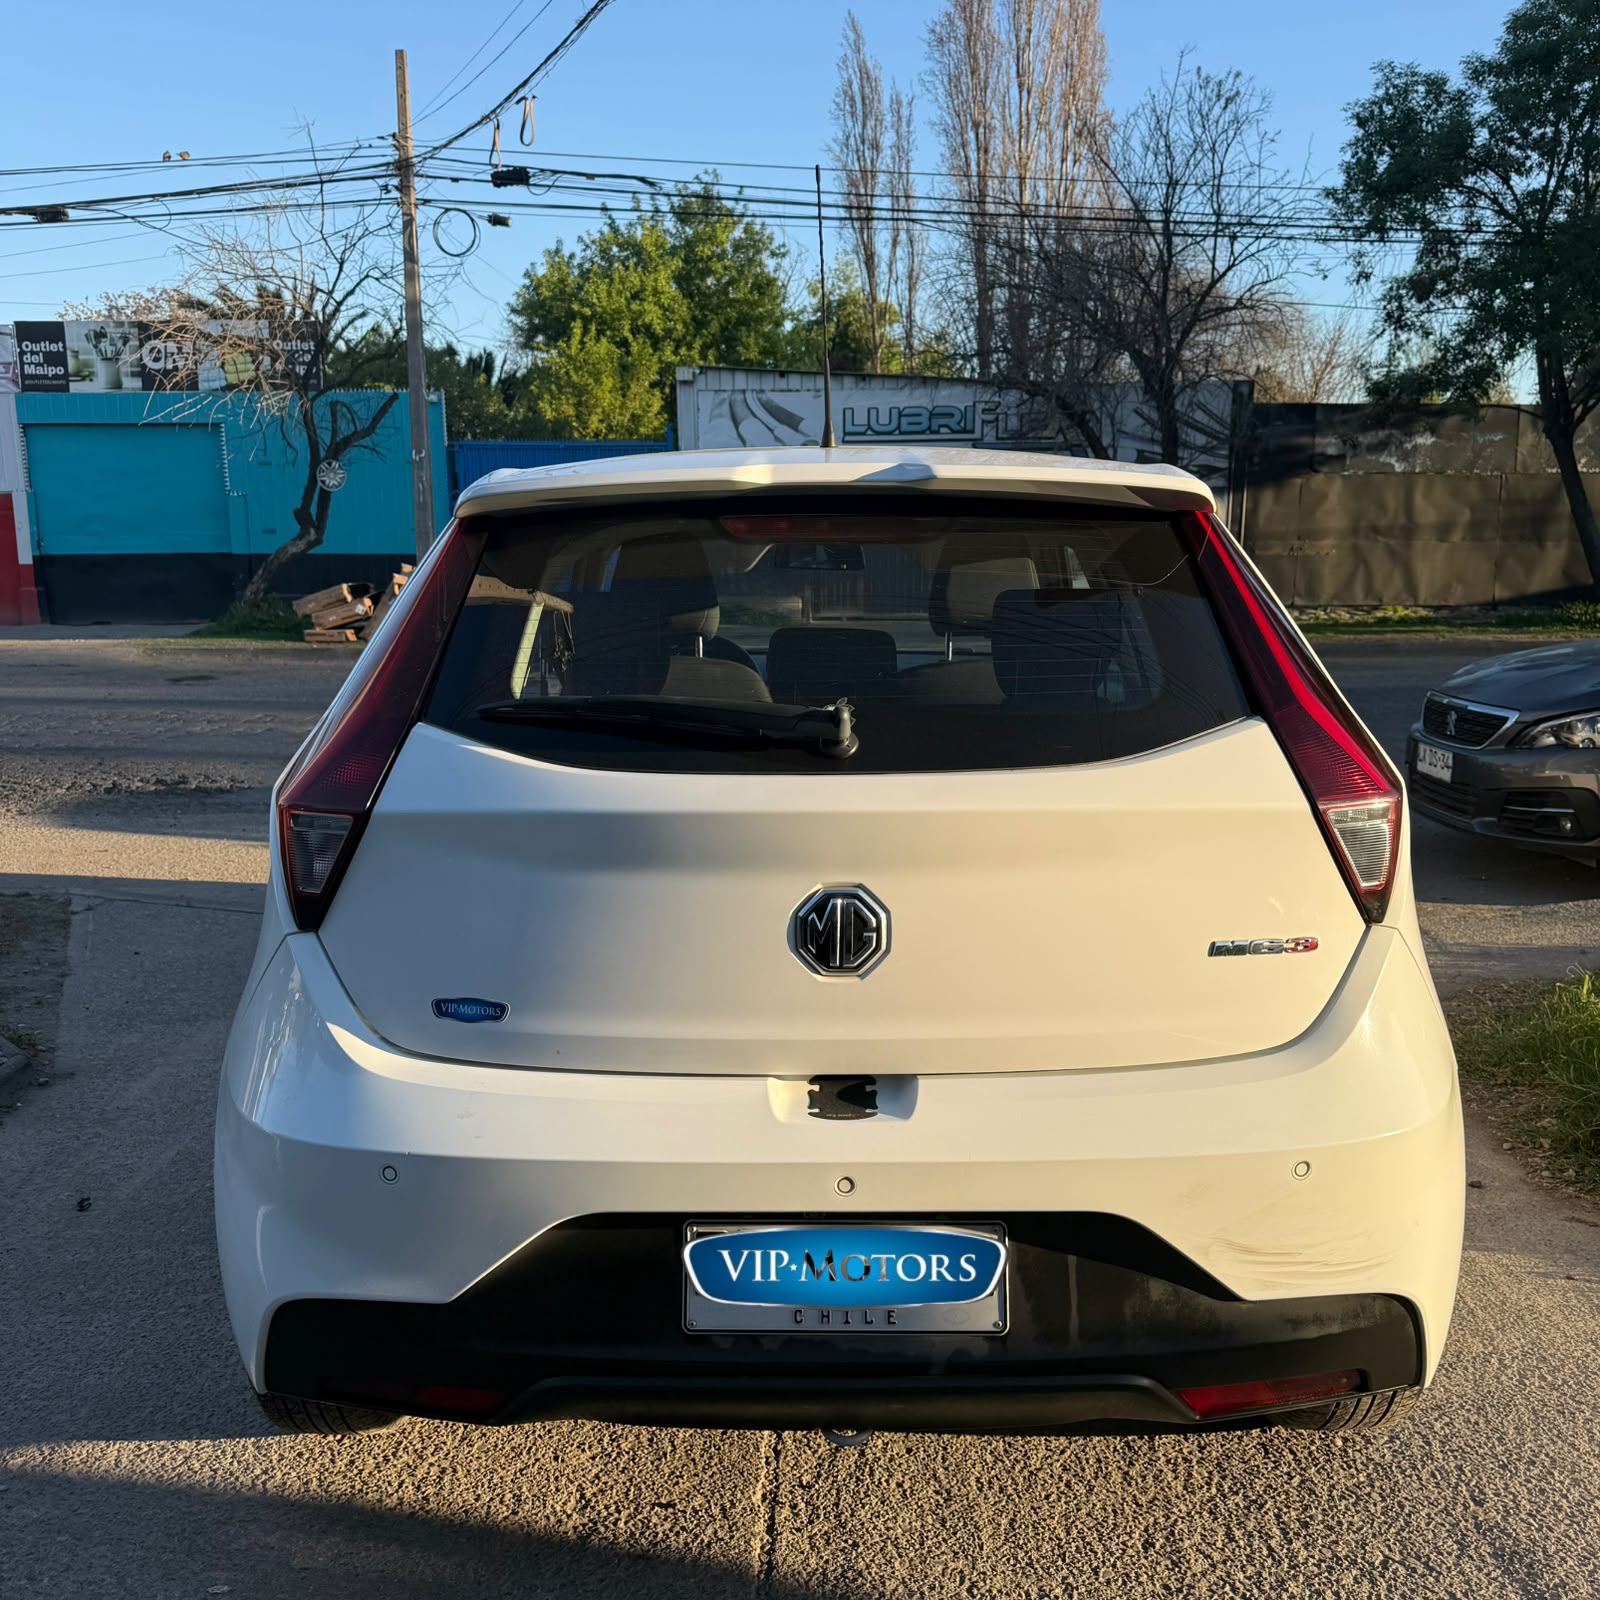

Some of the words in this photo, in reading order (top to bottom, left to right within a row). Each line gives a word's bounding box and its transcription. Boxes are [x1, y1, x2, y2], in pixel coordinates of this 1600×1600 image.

[21, 340, 65, 352] Outlet
[272, 340, 316, 351] Outlet
[23, 352, 44, 363] del
[24, 364, 65, 377] Maipo
[807, 898, 877, 967] MG
[1208, 937, 1319, 957] MG3
[793, 1308, 898, 1325] CHILE
